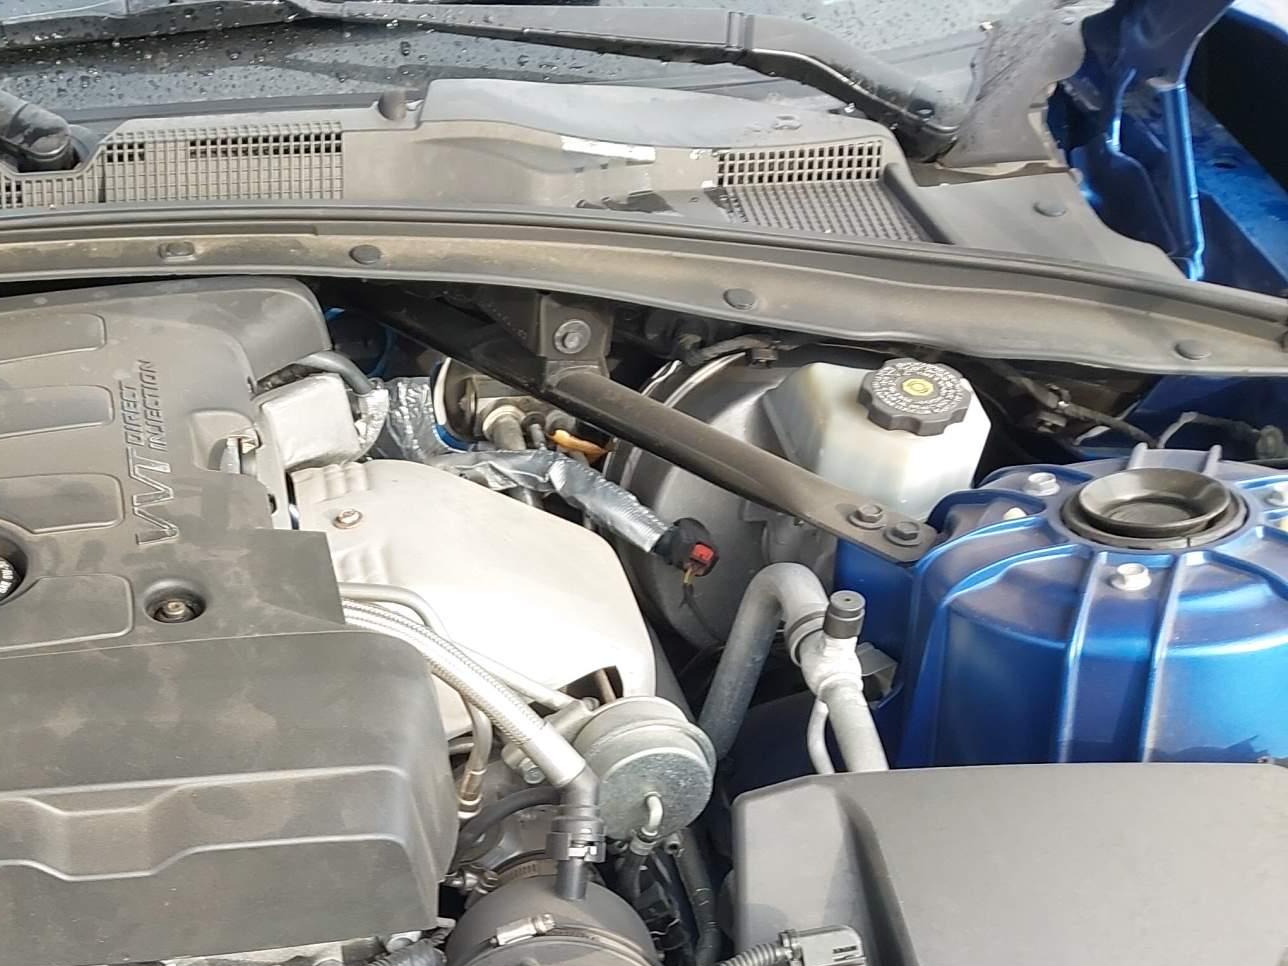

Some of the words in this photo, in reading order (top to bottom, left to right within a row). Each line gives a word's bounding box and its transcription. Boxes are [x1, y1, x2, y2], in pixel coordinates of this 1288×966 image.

[119, 380, 145, 448] DIRECT
[137, 360, 168, 452] INJECTION
[125, 447, 179, 546] VVT
